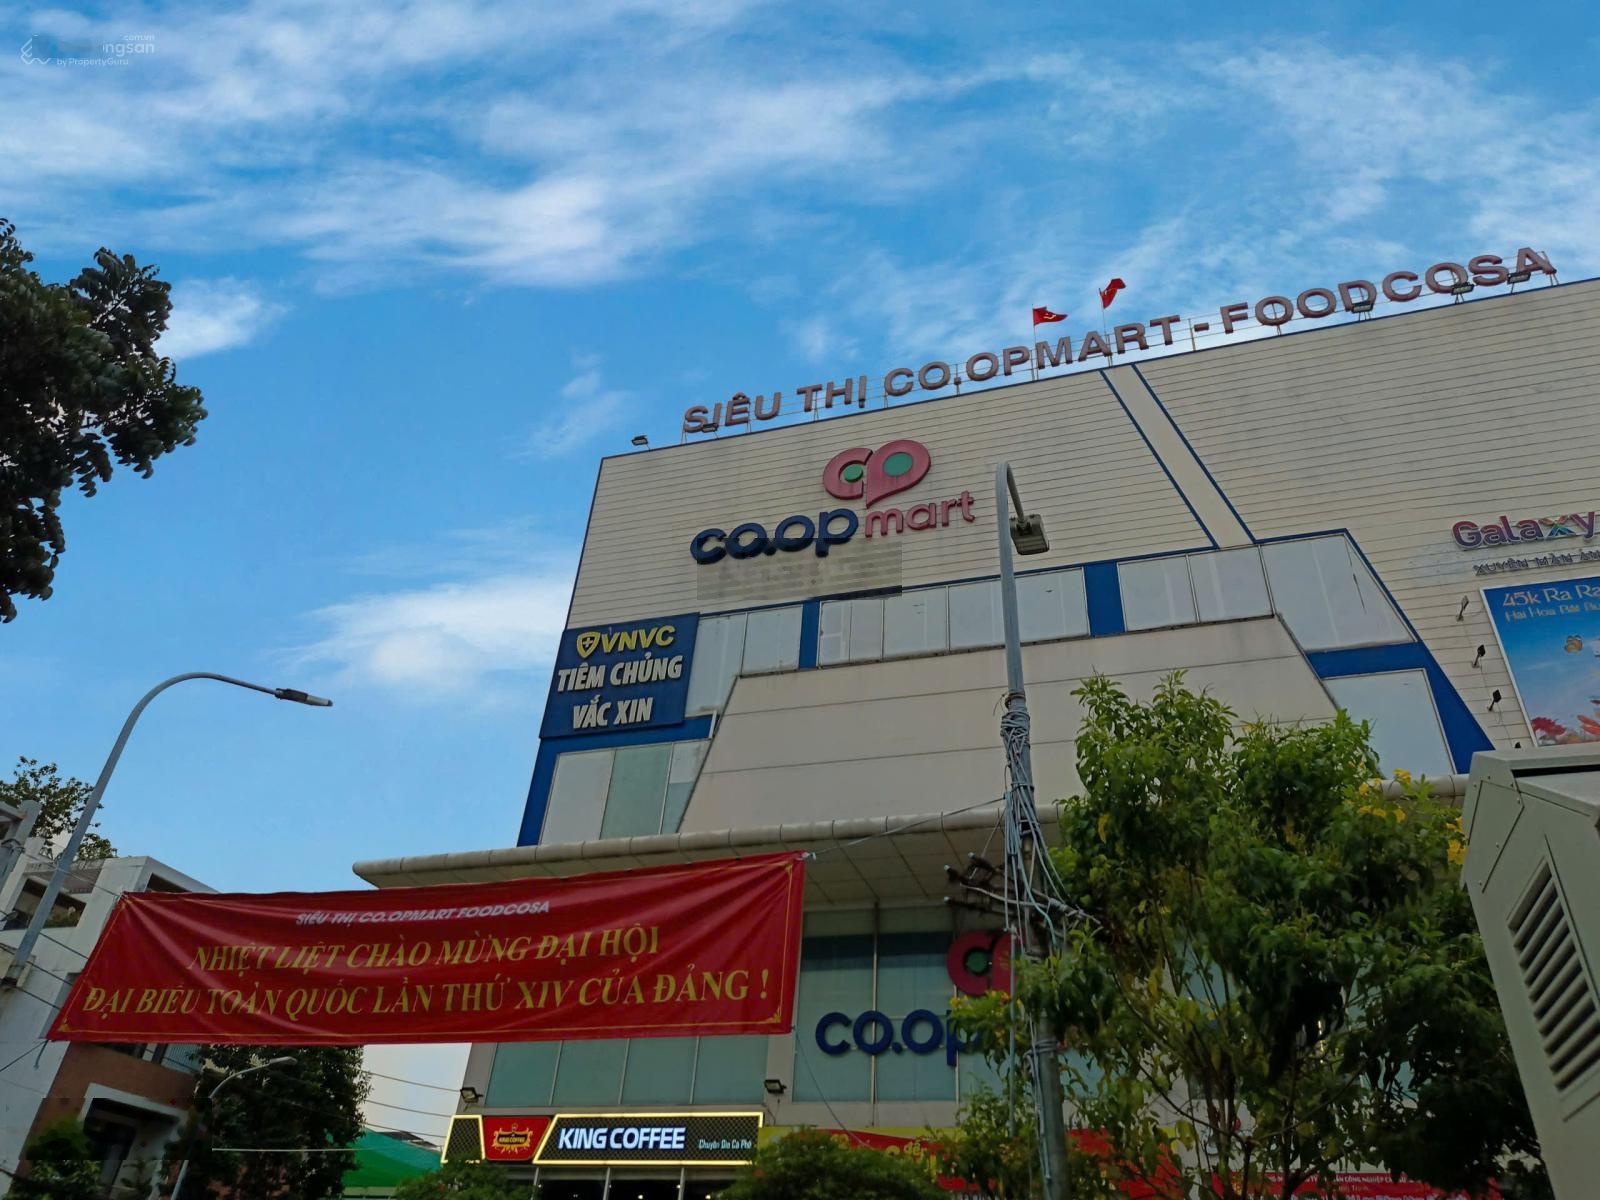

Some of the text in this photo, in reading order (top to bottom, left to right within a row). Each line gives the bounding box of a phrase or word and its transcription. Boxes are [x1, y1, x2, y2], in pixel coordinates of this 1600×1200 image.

[683, 392, 782, 433] SIÊU
[796, 375, 867, 408] THỊ
[690, 490, 976, 566] co.op mart
[1452, 511, 1596, 551] Galaxy
[1503, 590, 1541, 606] 45k
[1543, 587, 1573, 602] Ra
[601, 625, 676, 653] VNVC
[557, 651, 683, 692] TIÊM CHỦNG
[573, 694, 654, 729] VẮC XIN
[296, 901, 550, 927] SIÊU THỊ CO.OPMART FOODCOSA
[187, 923, 659, 977] NHIỆT LIỆT CHÀO MỪNG ĐẠI HỘI
[82, 986, 136, 1020] ĐẠI
[285, 978, 368, 1021] QUỐC
[442, 973, 511, 1012] THỨ
[514, 981, 575, 1009] XIV
[578, 968, 646, 1006] CỦA
[653, 964, 749, 1003] ĐẢNG
[559, 1127, 686, 1149] KING COFFEE
